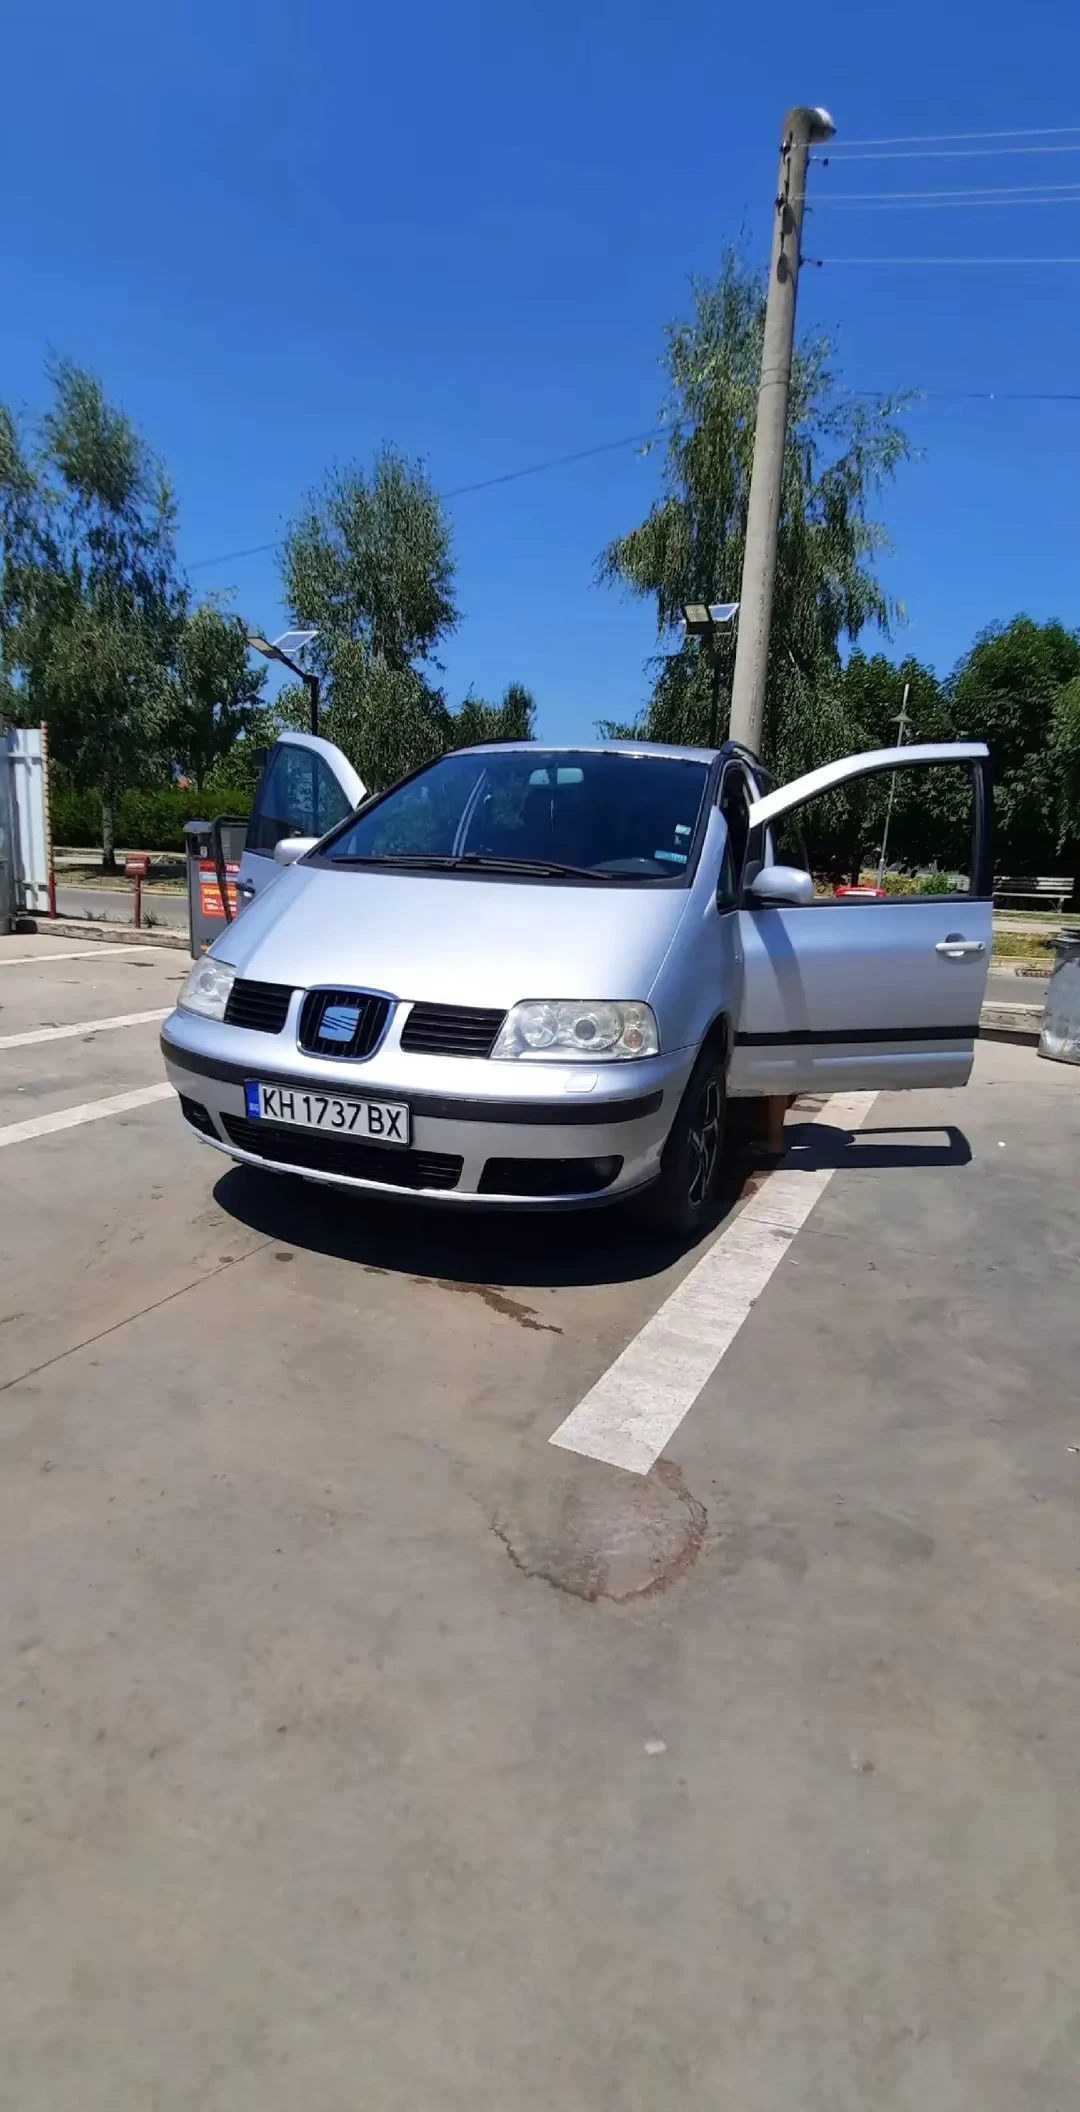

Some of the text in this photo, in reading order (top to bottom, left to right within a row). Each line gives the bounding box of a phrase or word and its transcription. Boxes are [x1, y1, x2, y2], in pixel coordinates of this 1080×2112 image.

[262, 1088, 402, 1138] KH 1737 BX
